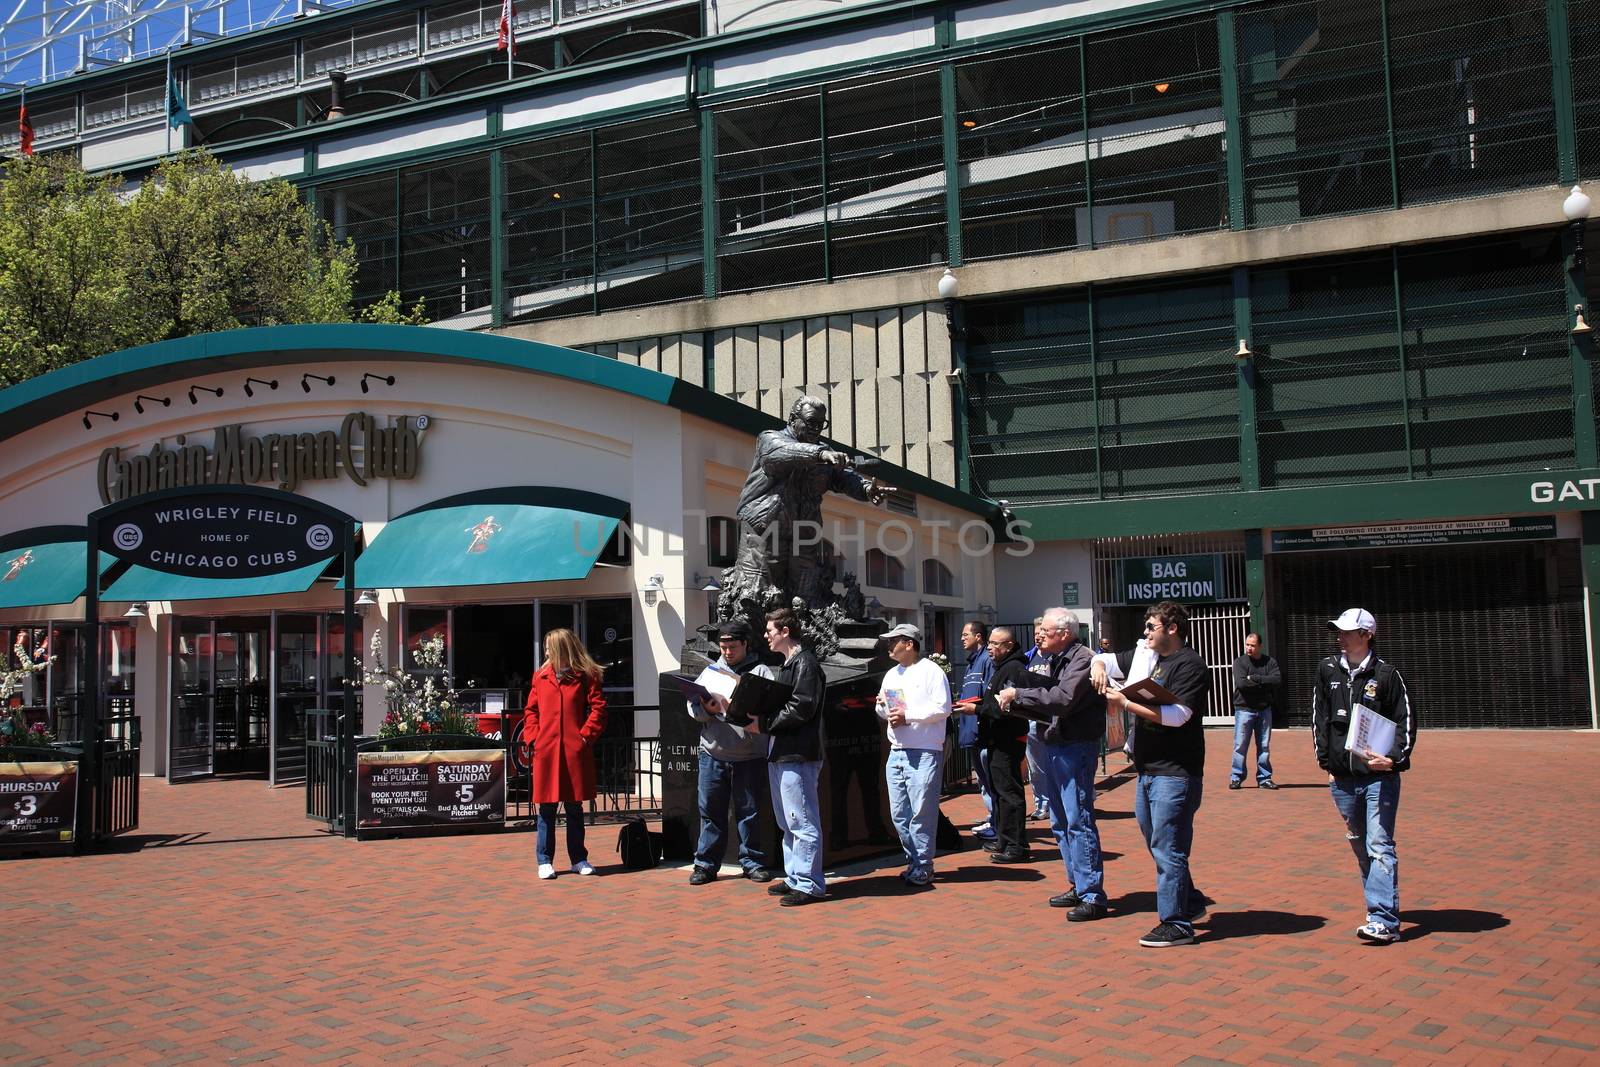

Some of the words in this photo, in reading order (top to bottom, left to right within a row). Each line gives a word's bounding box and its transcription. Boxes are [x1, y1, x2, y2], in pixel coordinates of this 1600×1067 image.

[97, 434, 208, 505] Captain
[211, 424, 337, 491] Morgan
[154, 507, 241, 524] WRIGLEY
[247, 508, 298, 526] FIELD
[1404, 523, 1442, 531] PROHIBITED
[200, 534, 231, 543] HOME
[236, 533, 250, 543] OF
[149, 550, 238, 569] CHICAGO
[248, 549, 298, 569] CUBS
[1151, 561, 1187, 579] BAG
[1128, 580, 1213, 600] INSPECTION
[408, 767, 419, 775] TO
[437, 764, 493, 774] SATURDAY
[667, 761, 673, 771] A
[390, 773, 429, 782] PUBLIC!!!
[438, 773, 446, 783] &
[448, 772, 491, 782] SUNDAY
[371, 791, 390, 799] BOOK
[455, 784, 474, 803] $5
[14, 795, 37, 816] $3
[372, 797, 393, 805] EVENT
[387, 806, 412, 814] DETAILS
[474, 803, 491, 811] Light
[16, 817, 42, 825] Island
[43, 816, 60, 824] 312
